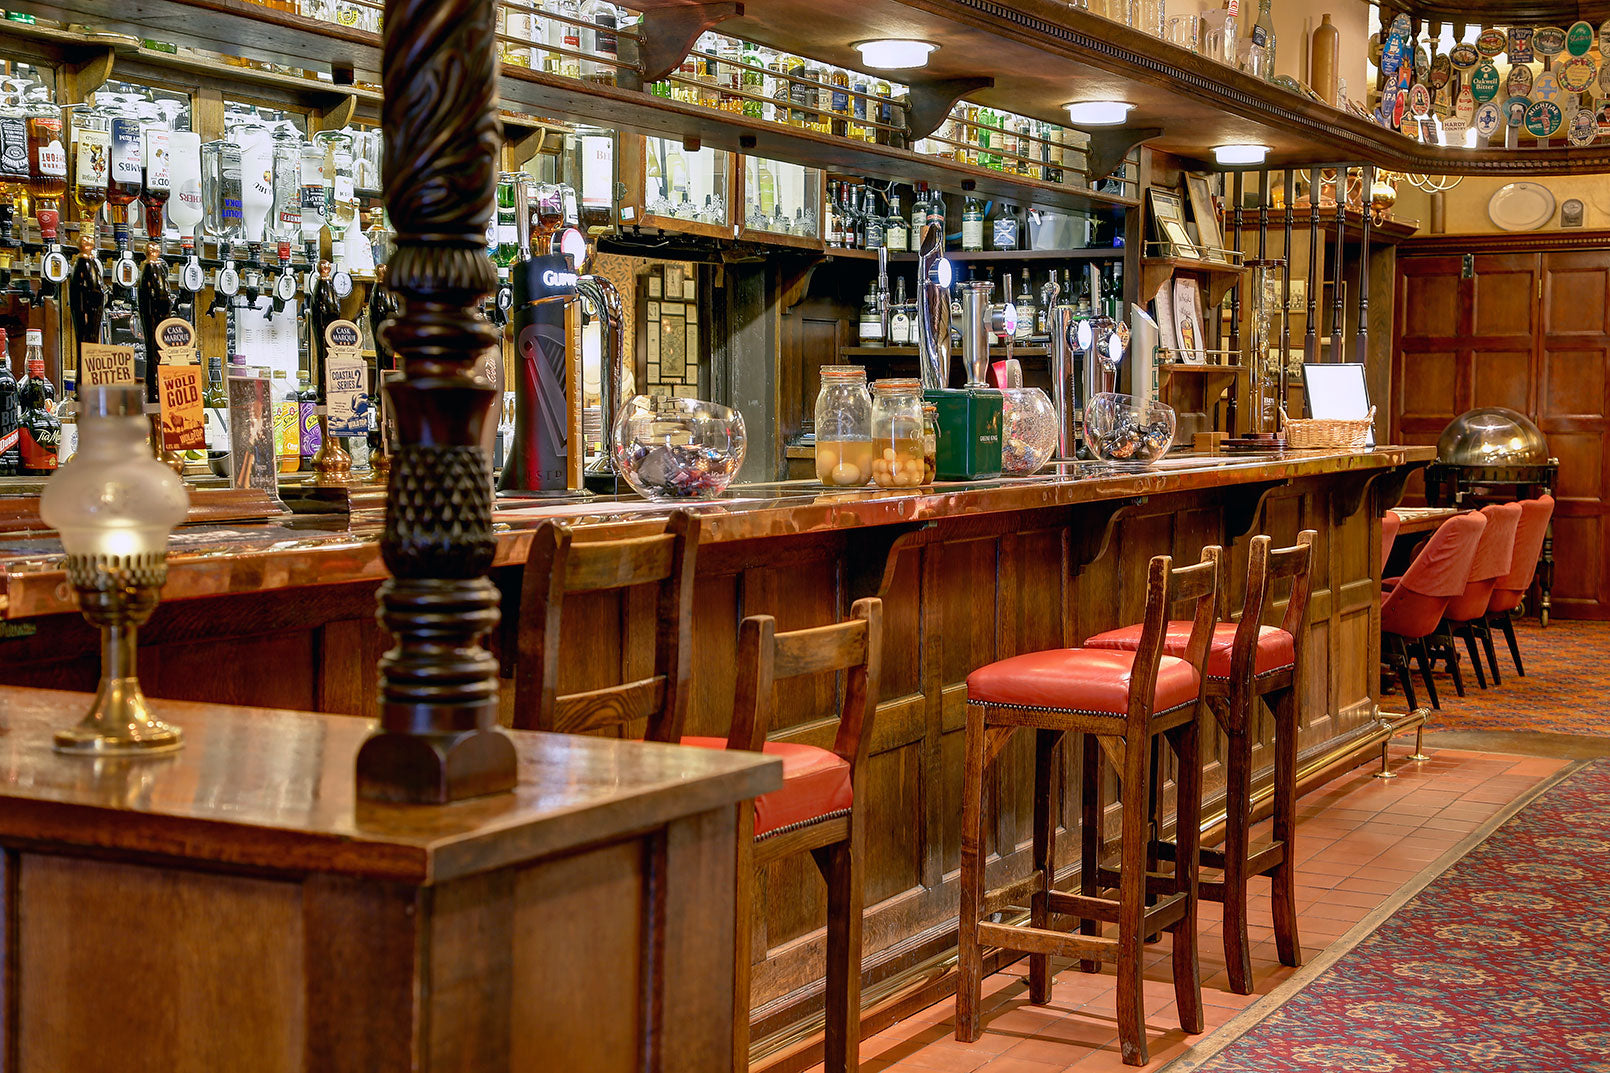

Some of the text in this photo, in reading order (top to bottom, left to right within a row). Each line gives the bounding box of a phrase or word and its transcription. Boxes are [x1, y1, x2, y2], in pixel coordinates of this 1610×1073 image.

[1383, 92, 1396, 101] IPA
[1528, 103, 1559, 116] NIGHTJAR
[166, 326, 183, 334] CASK
[335, 327, 351, 335] CASK
[163, 333, 189, 342] MARQUE
[332, 333, 356, 342] MARQUE
[572, 323, 580, 362] GATE
[90, 367, 131, 385] BITTER
[331, 370, 355, 381] COASTAL
[354, 369, 362, 389] 2
[164, 374, 196, 391] WOLD
[336, 380, 356, 390] SERIES
[166, 385, 199, 408] GOLD
